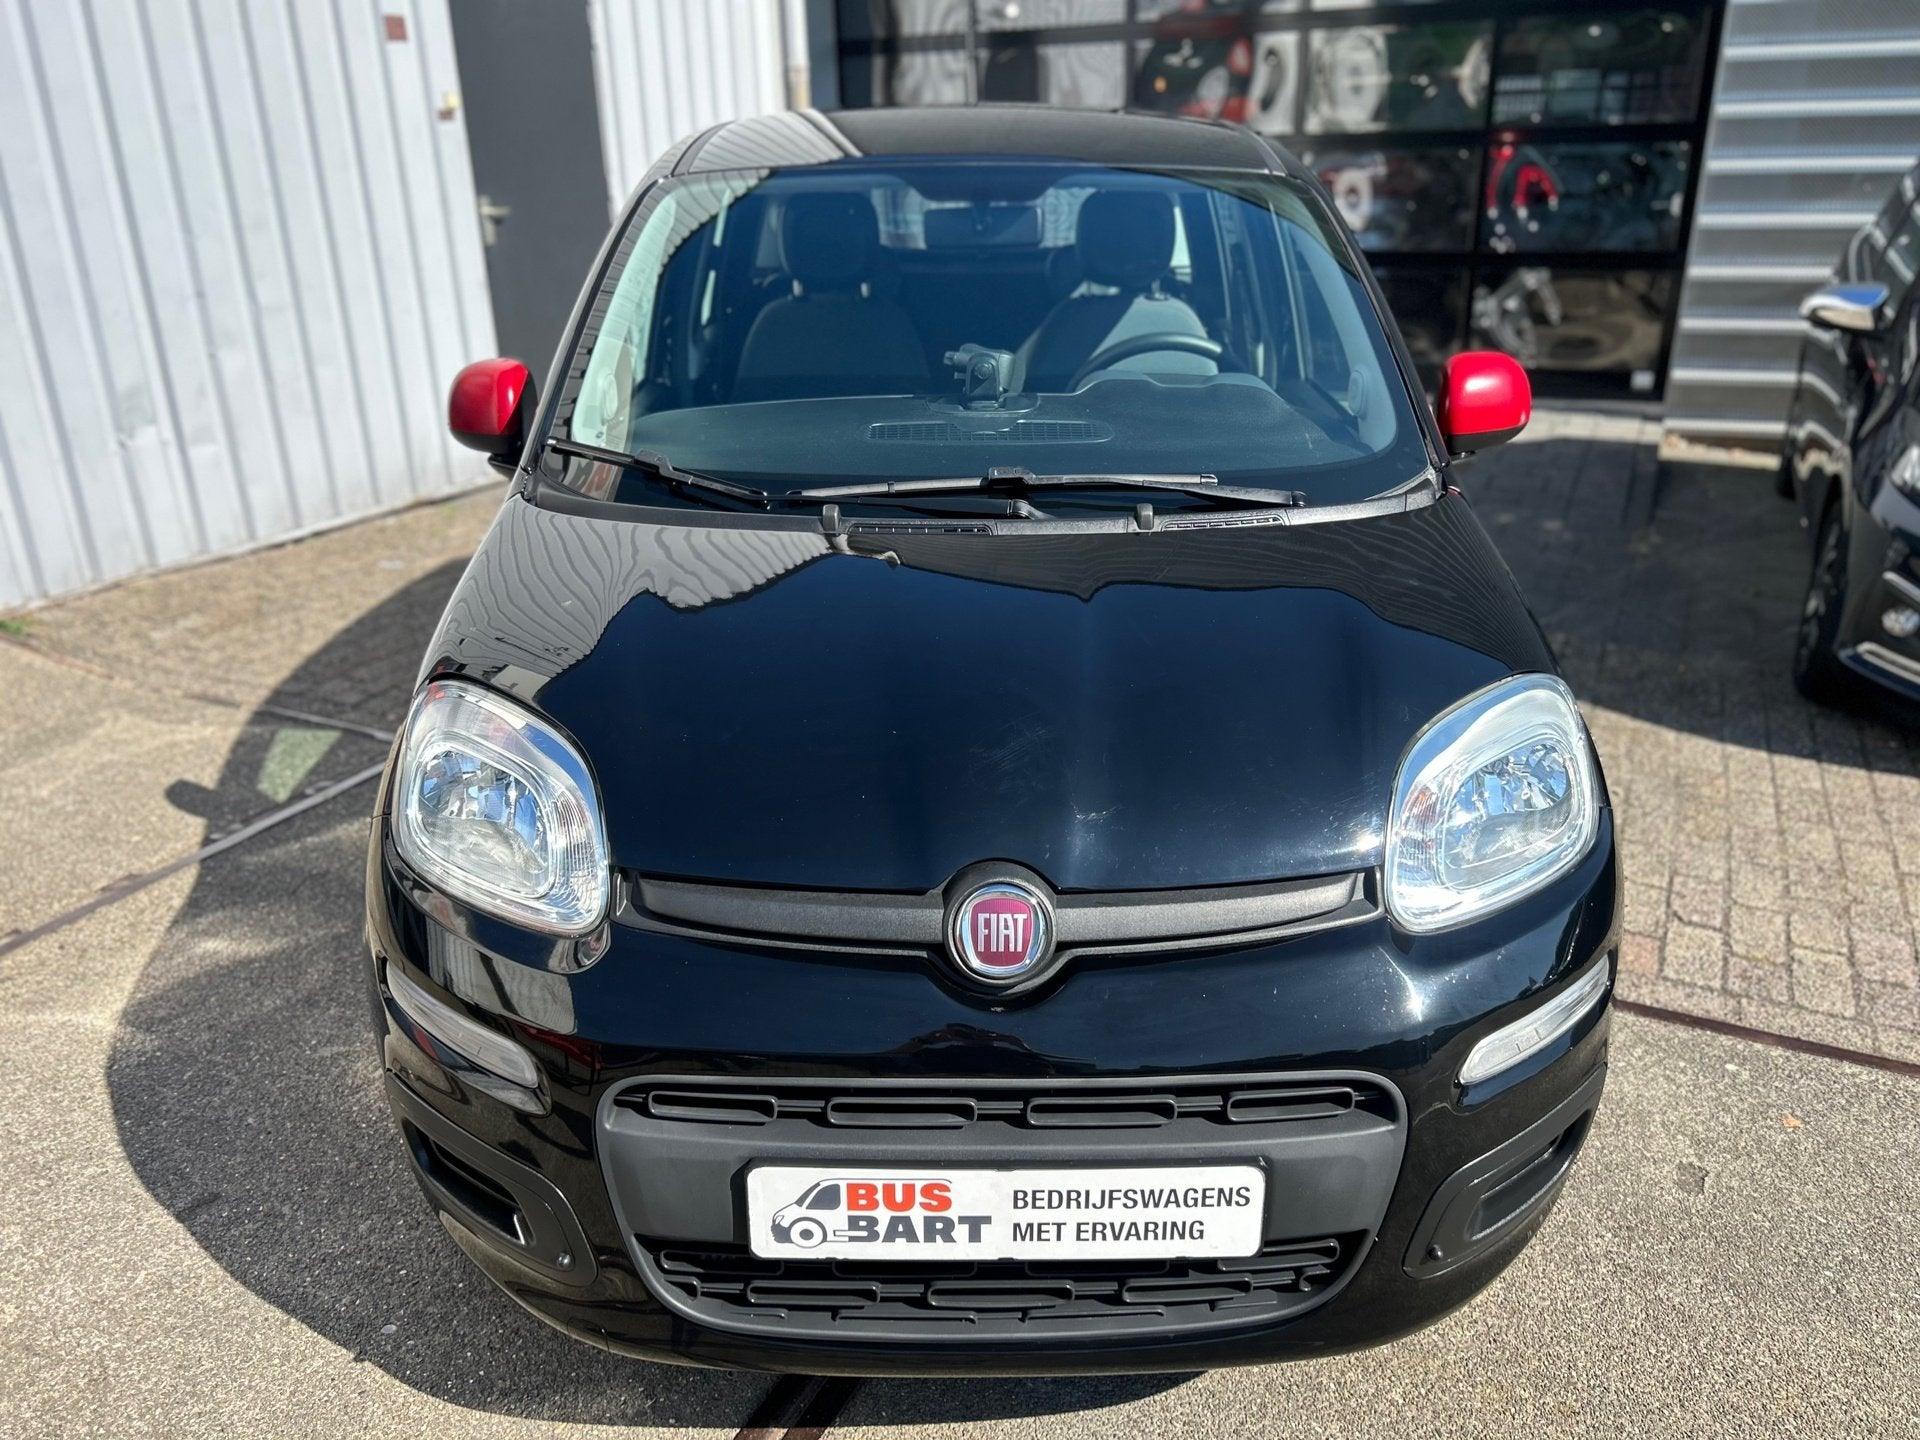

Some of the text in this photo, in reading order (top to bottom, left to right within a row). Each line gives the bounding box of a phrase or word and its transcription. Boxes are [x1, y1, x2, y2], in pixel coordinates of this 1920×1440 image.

[977, 913, 1028, 953] FIAT
[846, 1182, 953, 1213] BUS
[1012, 1186, 1252, 1210] BEDRIJFSWAGENS
[846, 1214, 993, 1244] BART
[1012, 1220, 1205, 1242] MET ERVARING
